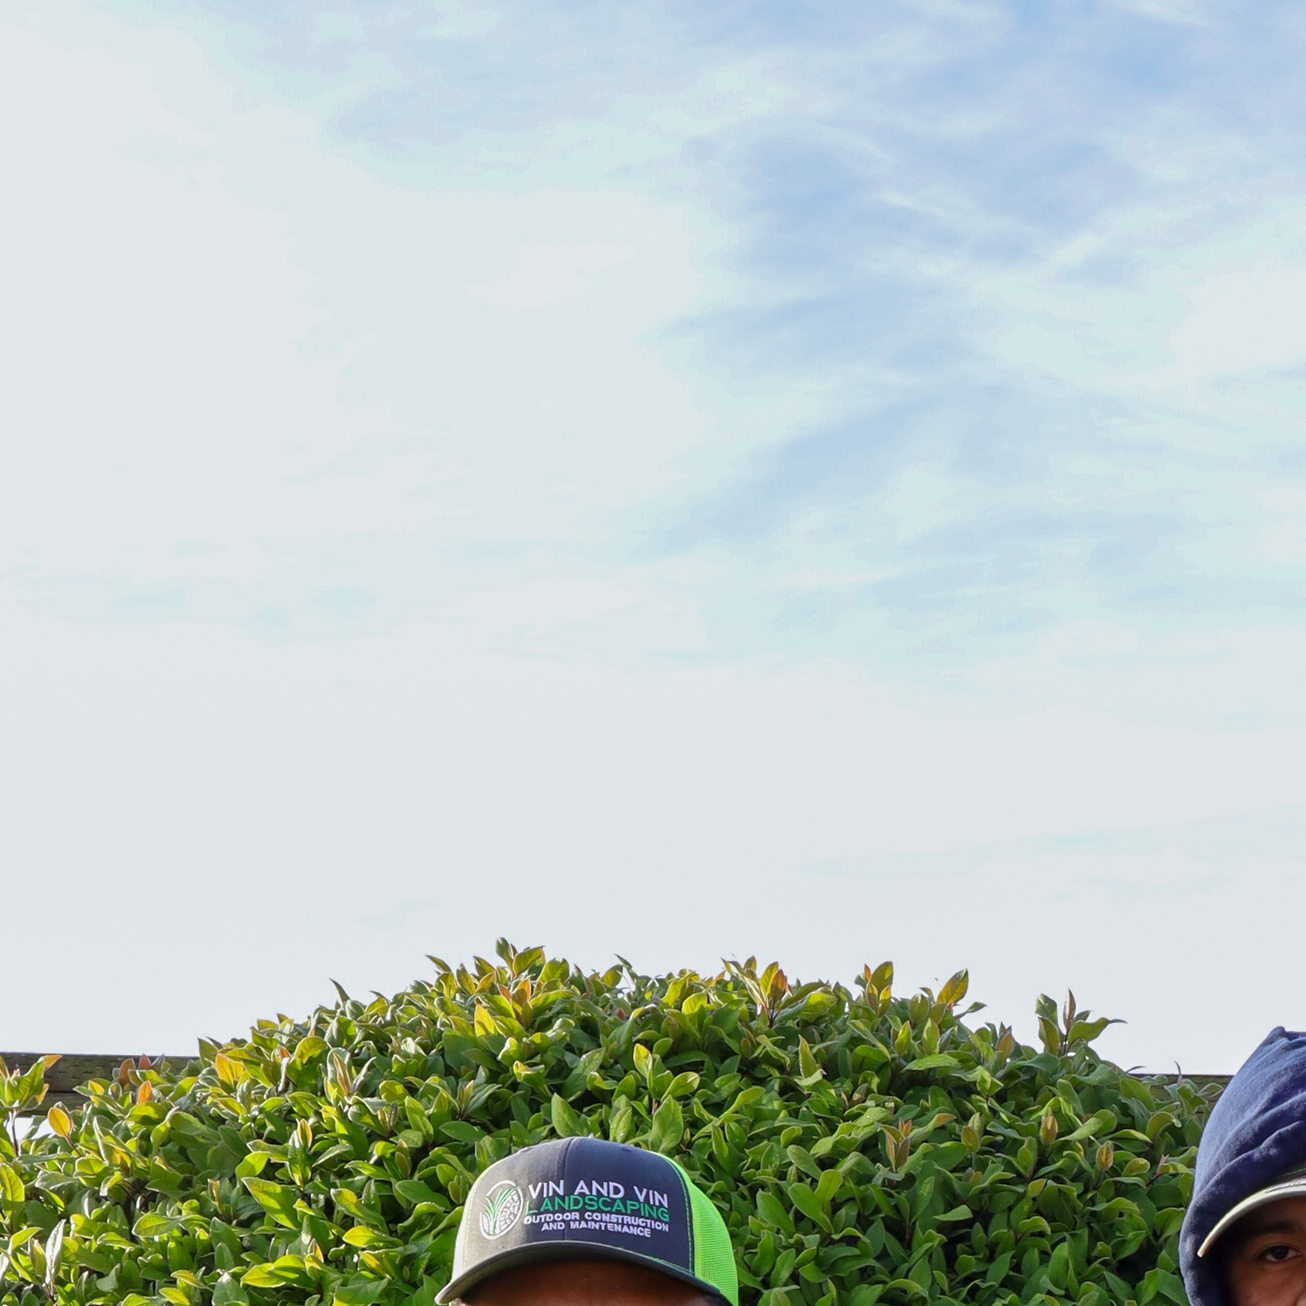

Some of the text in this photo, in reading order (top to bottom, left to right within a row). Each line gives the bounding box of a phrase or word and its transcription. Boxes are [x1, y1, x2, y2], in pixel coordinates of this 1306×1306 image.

[528, 1180, 669, 1208] VIN AND VIN
[525, 1195, 670, 1222] LANDSCAPING
[524, 1212, 669, 1232] OUTDOOR CONSTRUCTION
[541, 1220, 651, 1238] AND MAINTENANCE
